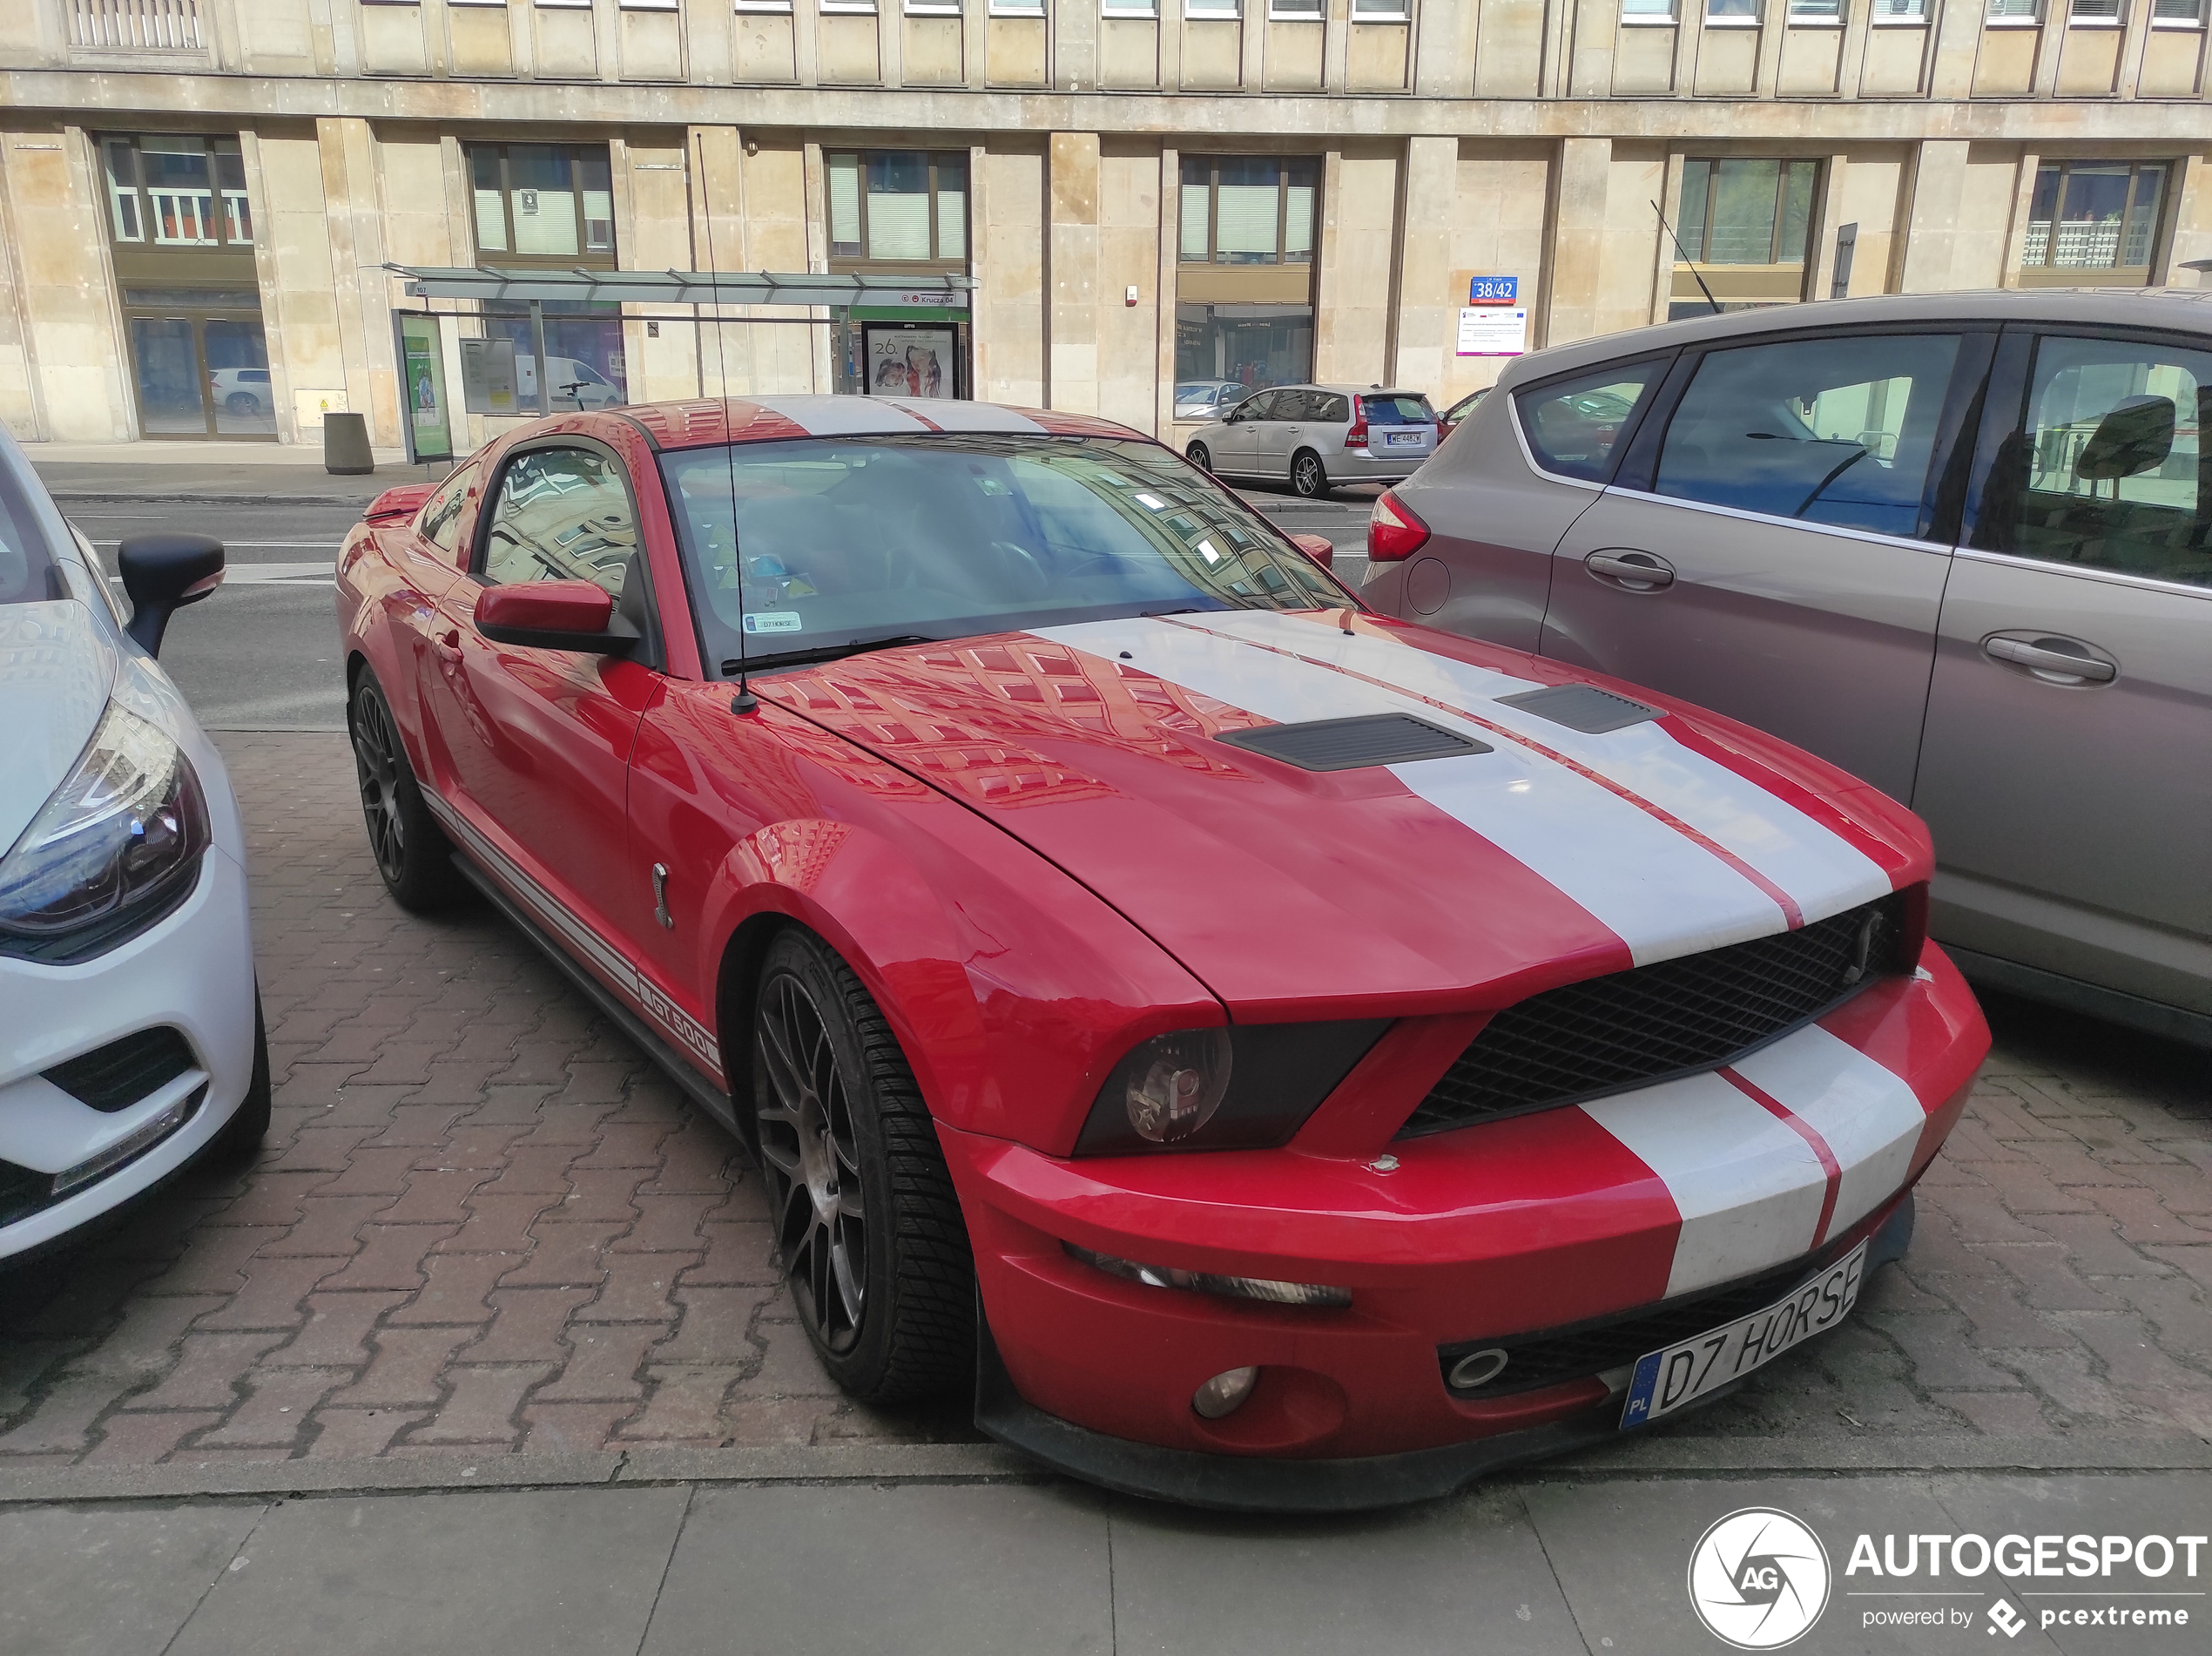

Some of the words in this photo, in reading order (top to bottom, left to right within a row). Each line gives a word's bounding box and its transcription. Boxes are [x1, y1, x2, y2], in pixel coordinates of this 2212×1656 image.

[1476, 282, 1513, 299] 38/42
[651, 993, 670, 1022] GT
[671, 1010, 707, 1054] 500
[1660, 1333, 1729, 1410] D7
[1733, 1250, 1864, 1374] HORSE
[1629, 1398, 1648, 1416] PL
